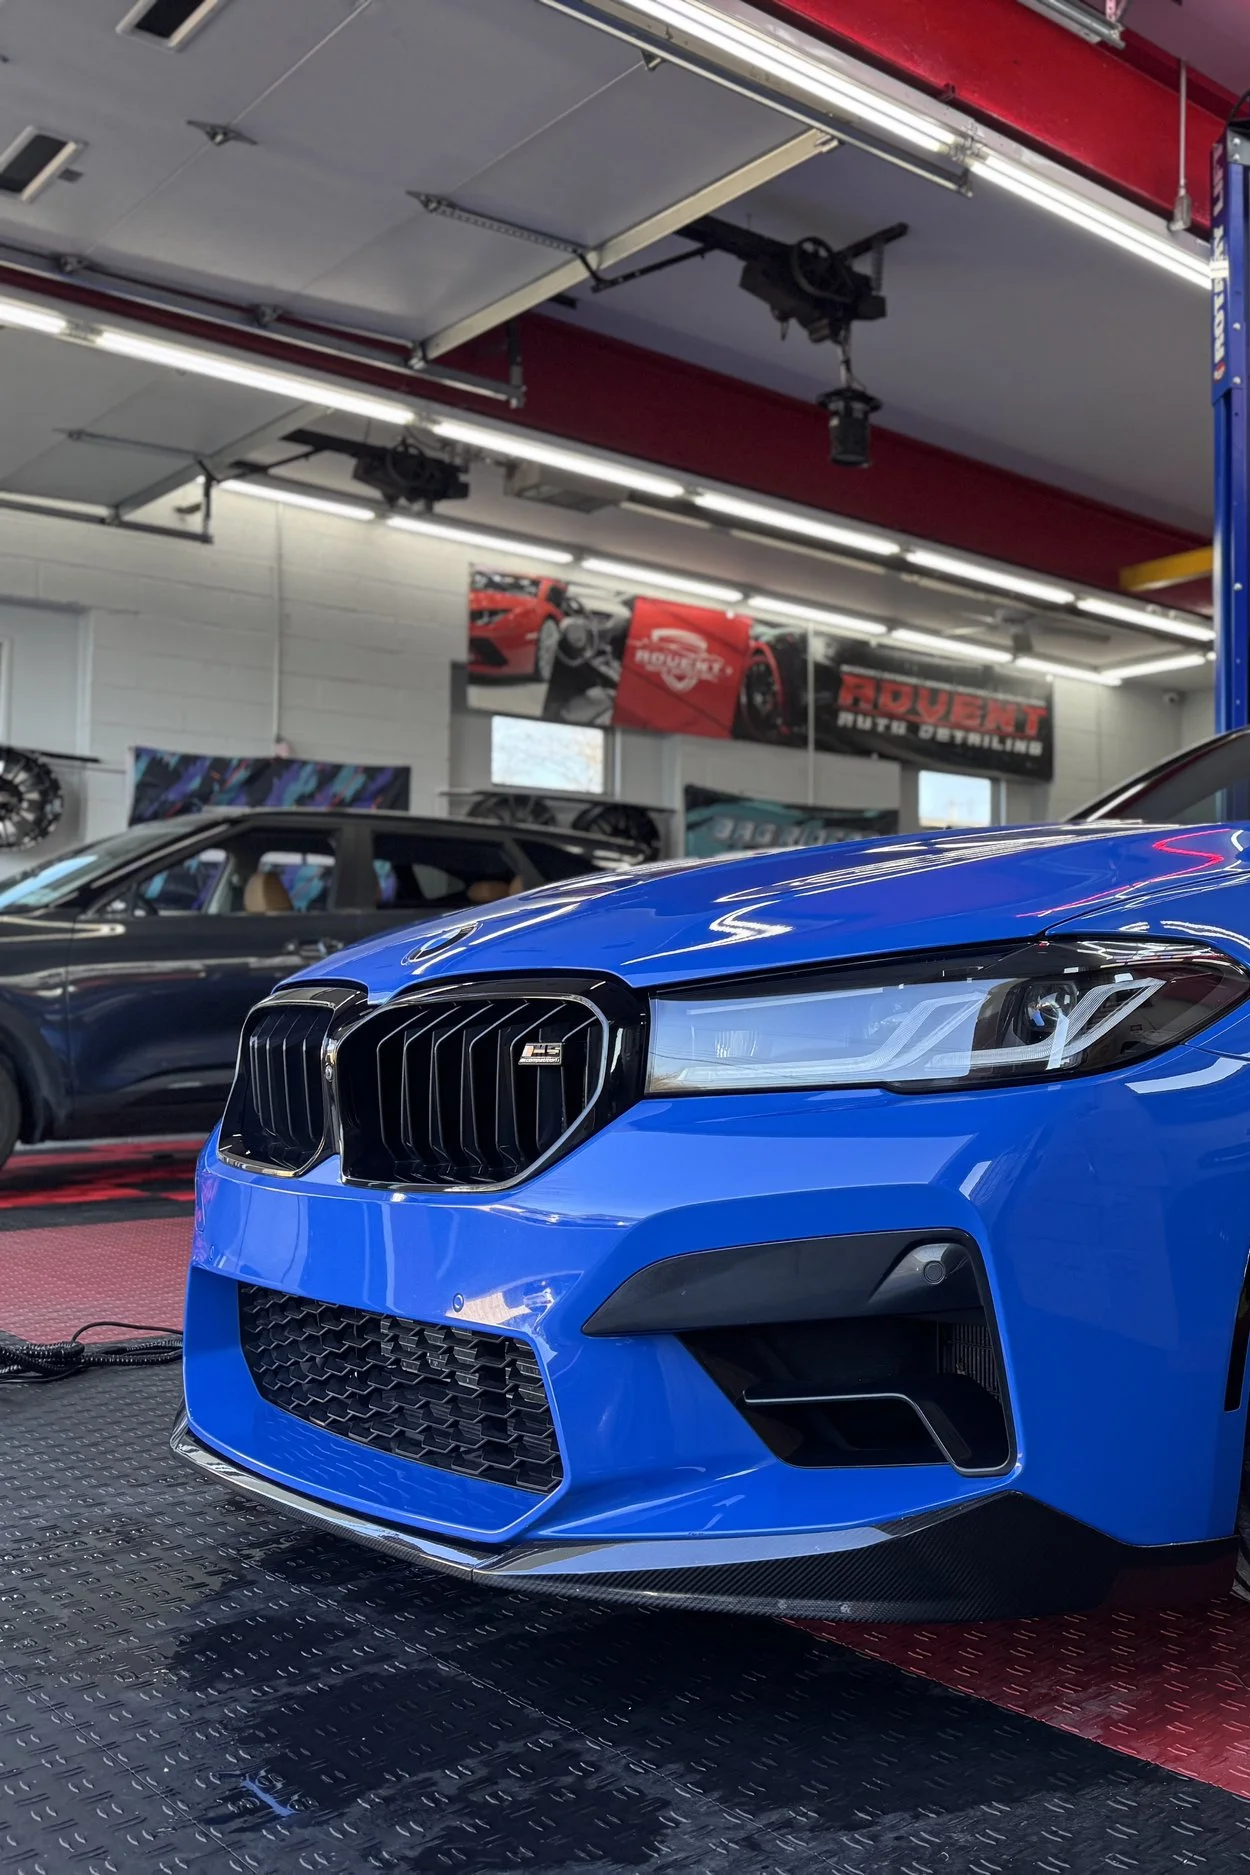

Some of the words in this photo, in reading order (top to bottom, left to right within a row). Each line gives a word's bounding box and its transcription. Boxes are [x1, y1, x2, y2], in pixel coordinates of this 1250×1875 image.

[837, 672, 1048, 737] ADVENT
[837, 710, 907, 737] AUTO
[918, 724, 1044, 757] DETAILING
